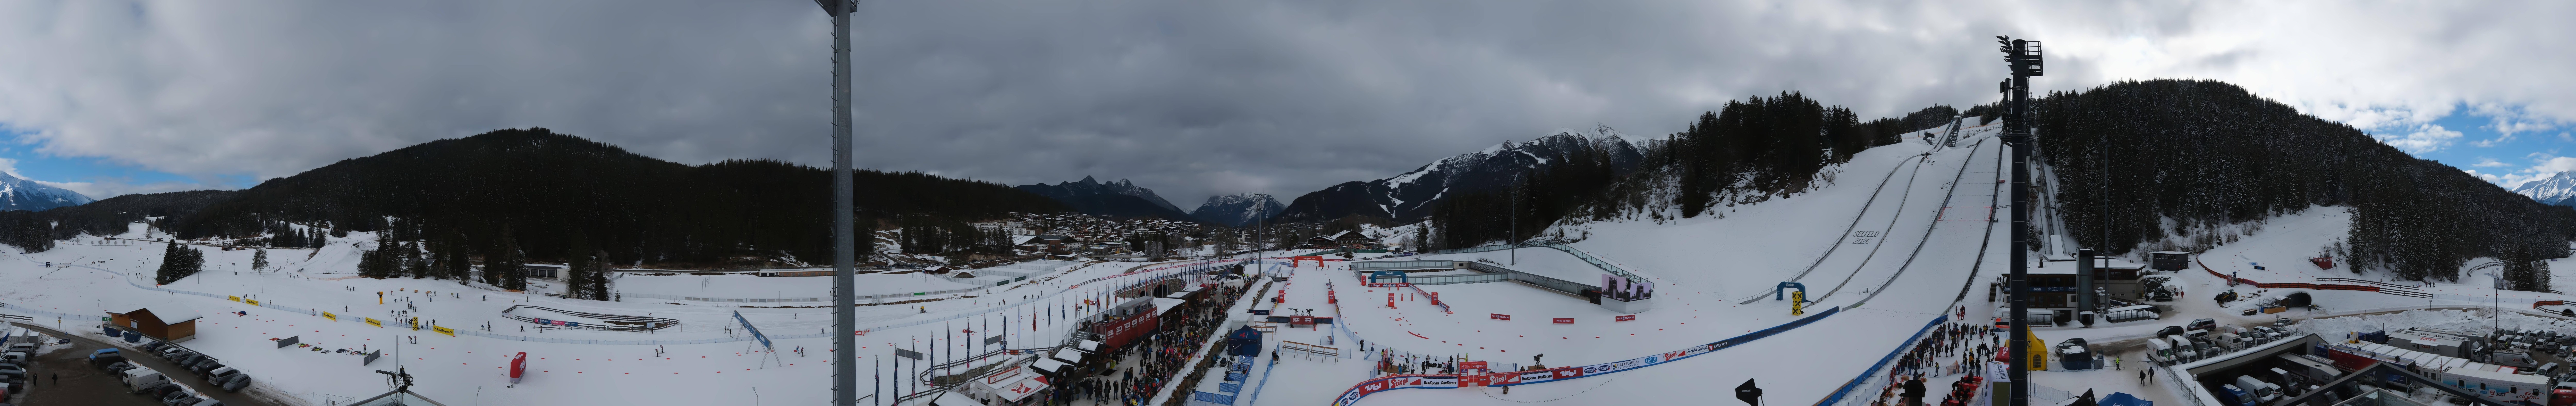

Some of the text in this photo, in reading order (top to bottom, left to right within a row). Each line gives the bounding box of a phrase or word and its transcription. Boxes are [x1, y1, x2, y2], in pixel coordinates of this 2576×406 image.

[1665, 351, 1676, 361] Stiegl
[1997, 364, 2006, 379] CASABLANCA
[1391, 377, 1408, 388] Stiegl
[1489, 375, 1506, 385] Stiegl
[1011, 382, 1025, 394] Stiegl
[1365, 383, 1381, 391] Tirol
